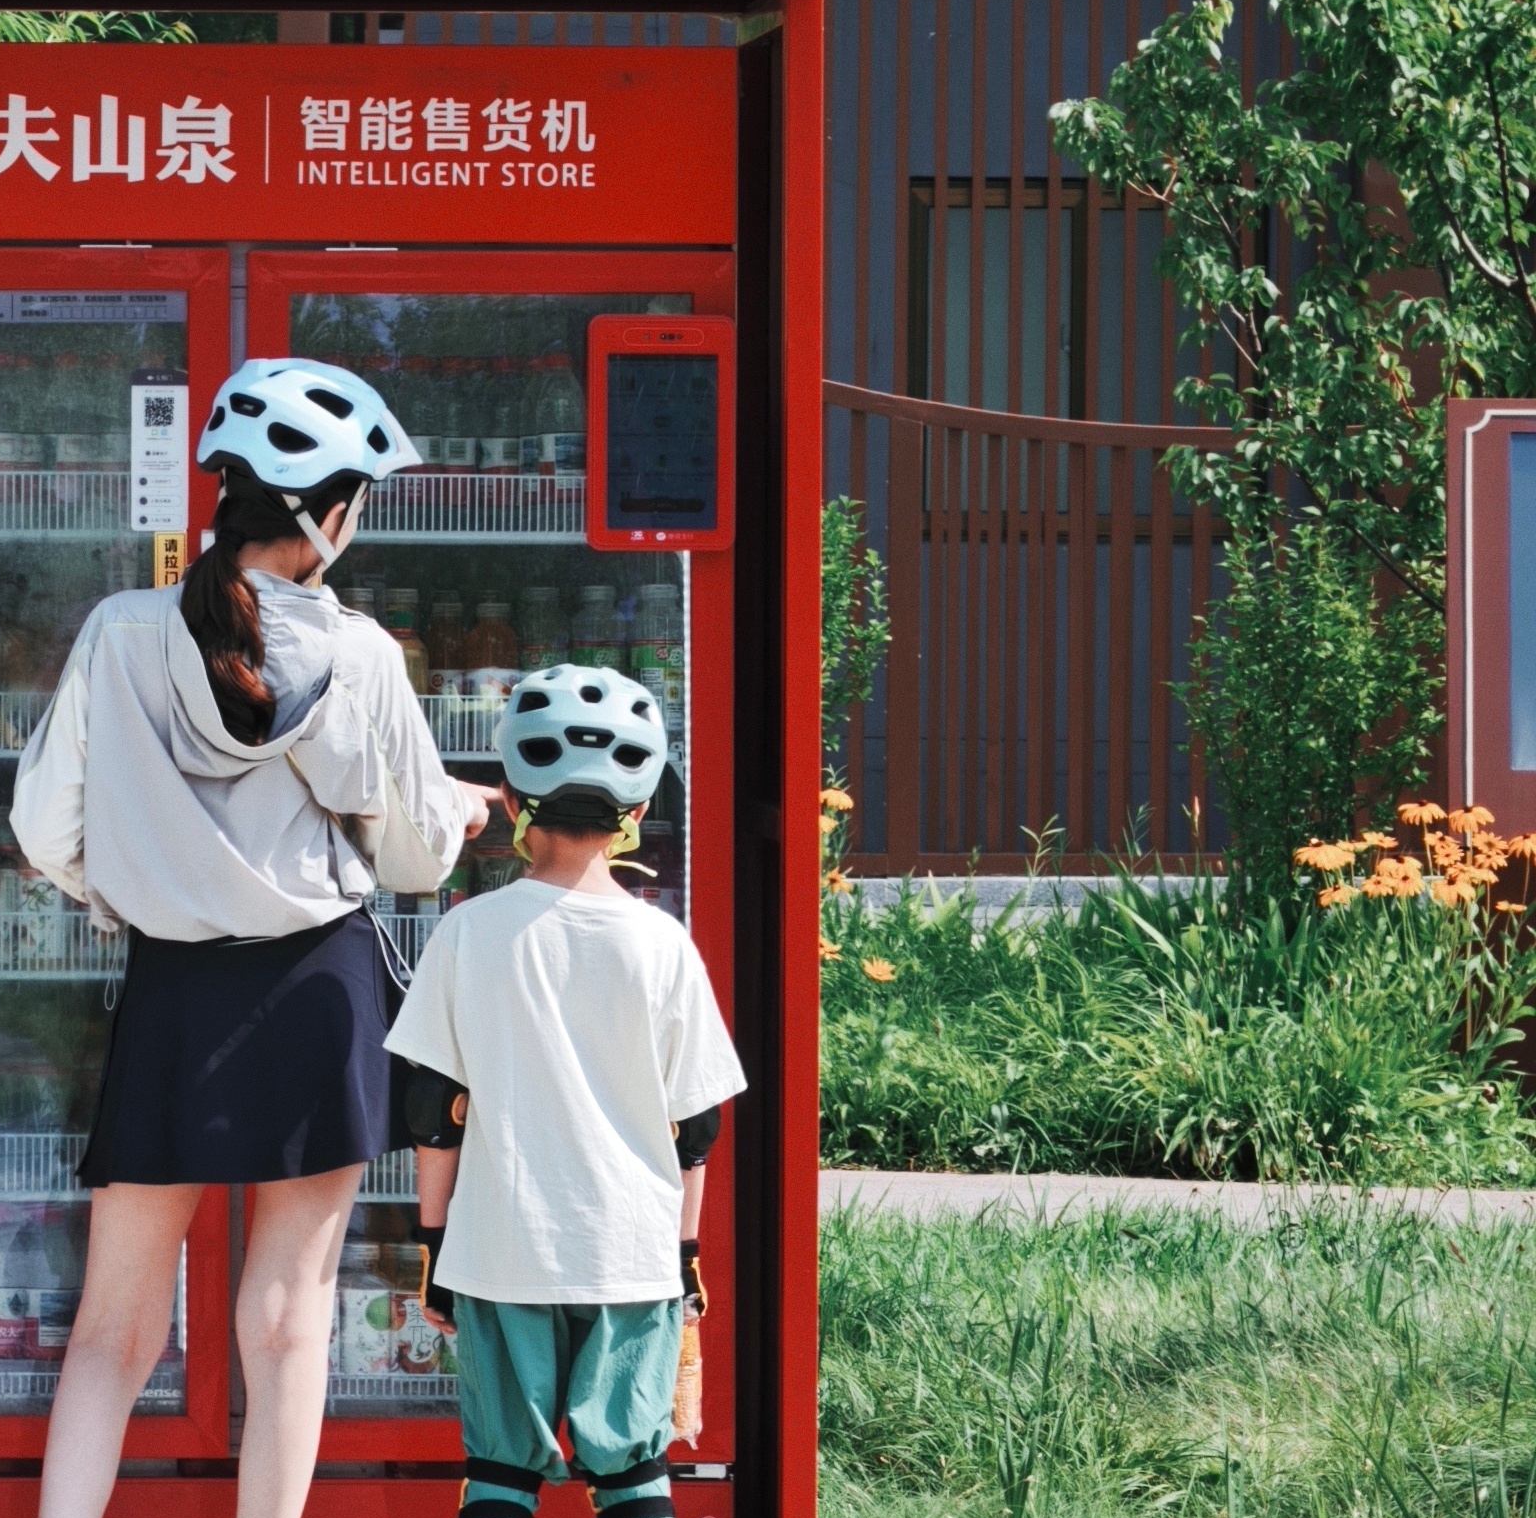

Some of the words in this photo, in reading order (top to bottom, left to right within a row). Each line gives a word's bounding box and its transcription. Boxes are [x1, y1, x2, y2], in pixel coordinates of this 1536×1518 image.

[300, 96, 596, 153] 智能售货机
[298, 162, 490, 187] INTELLIGENT
[502, 162, 596, 187] STORE
[164, 539, 179, 585] 请拉门
